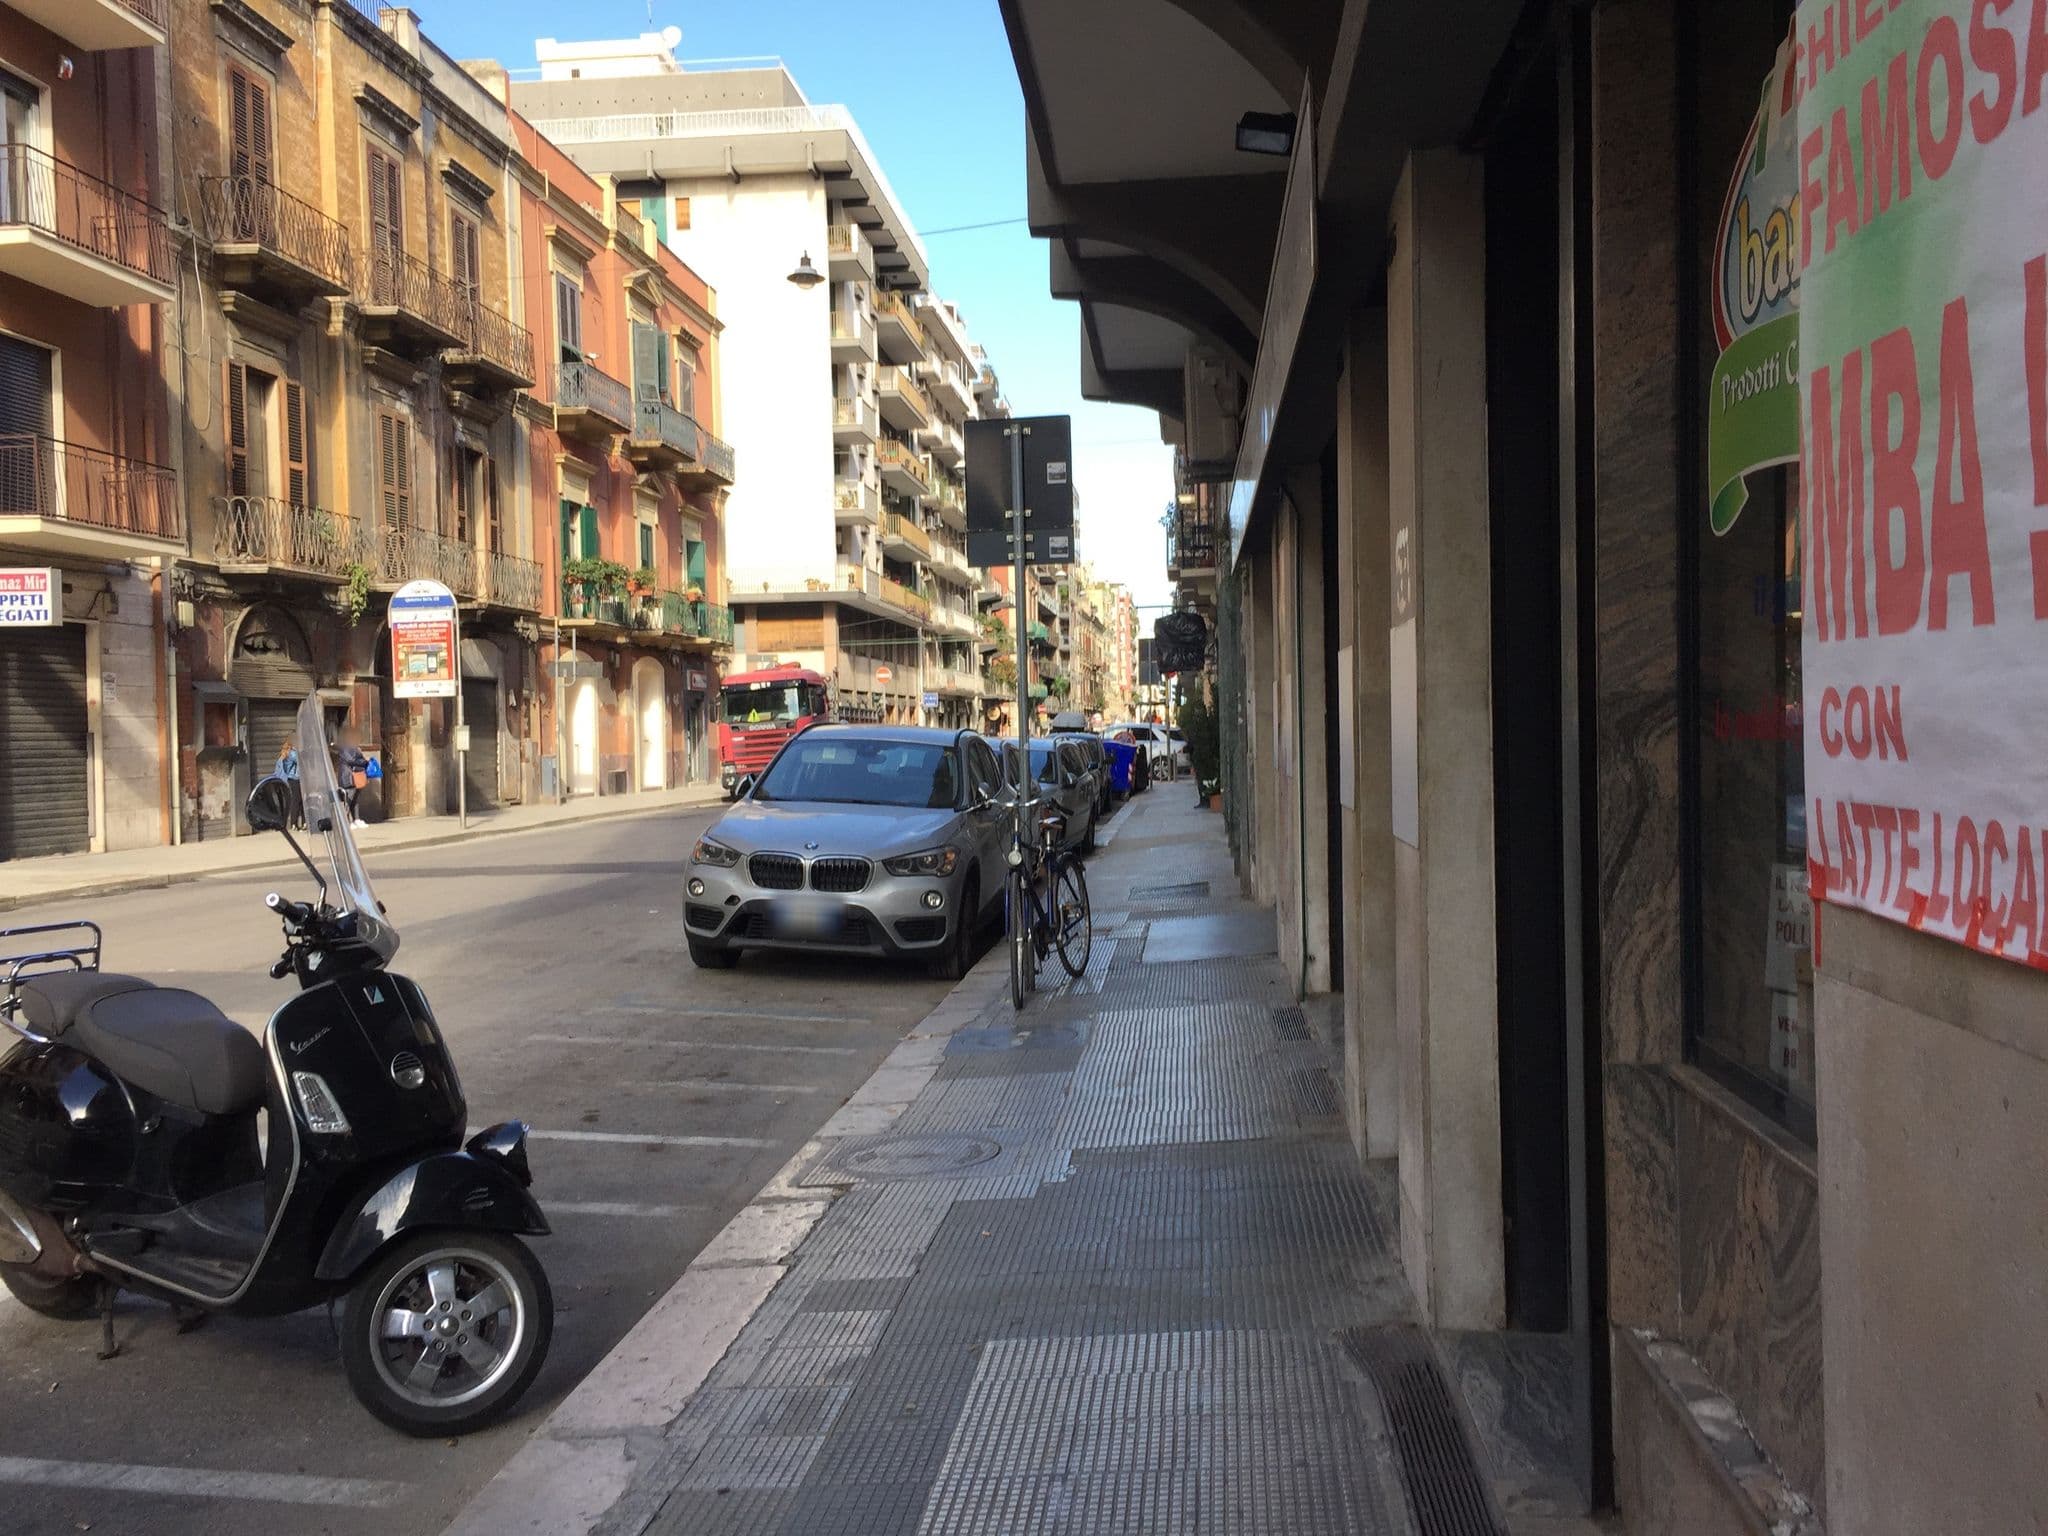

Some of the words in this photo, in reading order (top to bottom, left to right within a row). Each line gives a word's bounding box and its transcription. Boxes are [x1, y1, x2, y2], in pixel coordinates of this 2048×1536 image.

[1785, 340, 1799, 385] C
[1819, 684, 1908, 761] CON
[1814, 797, 1920, 913] LATTE
